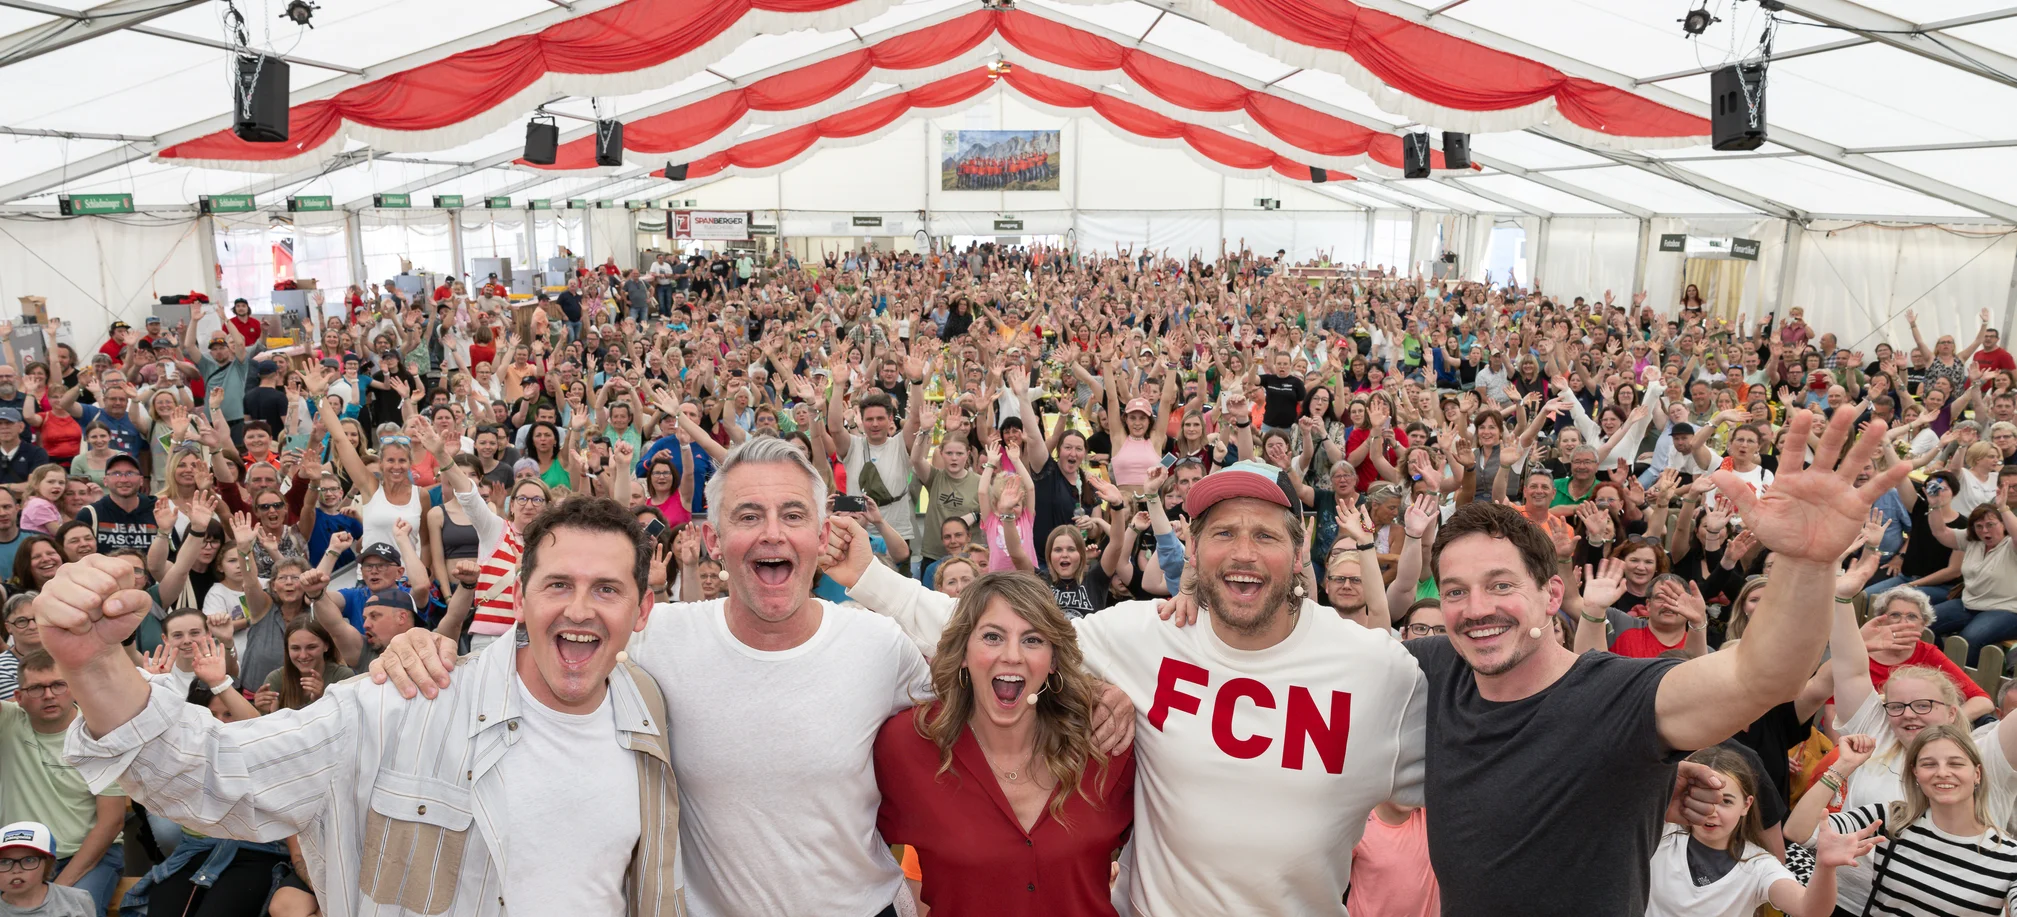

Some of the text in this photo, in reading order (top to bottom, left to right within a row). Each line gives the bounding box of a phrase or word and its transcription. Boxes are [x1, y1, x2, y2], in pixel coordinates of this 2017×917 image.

[84, 198, 120, 209] Schladminger
[694, 217, 743, 225] SPANBERGER
[1663, 239, 1681, 248] Fotobox
[1733, 243, 1757, 256] Fanartikel
[111, 522, 148, 534] JEAN
[1147, 656, 1352, 775] FCN
